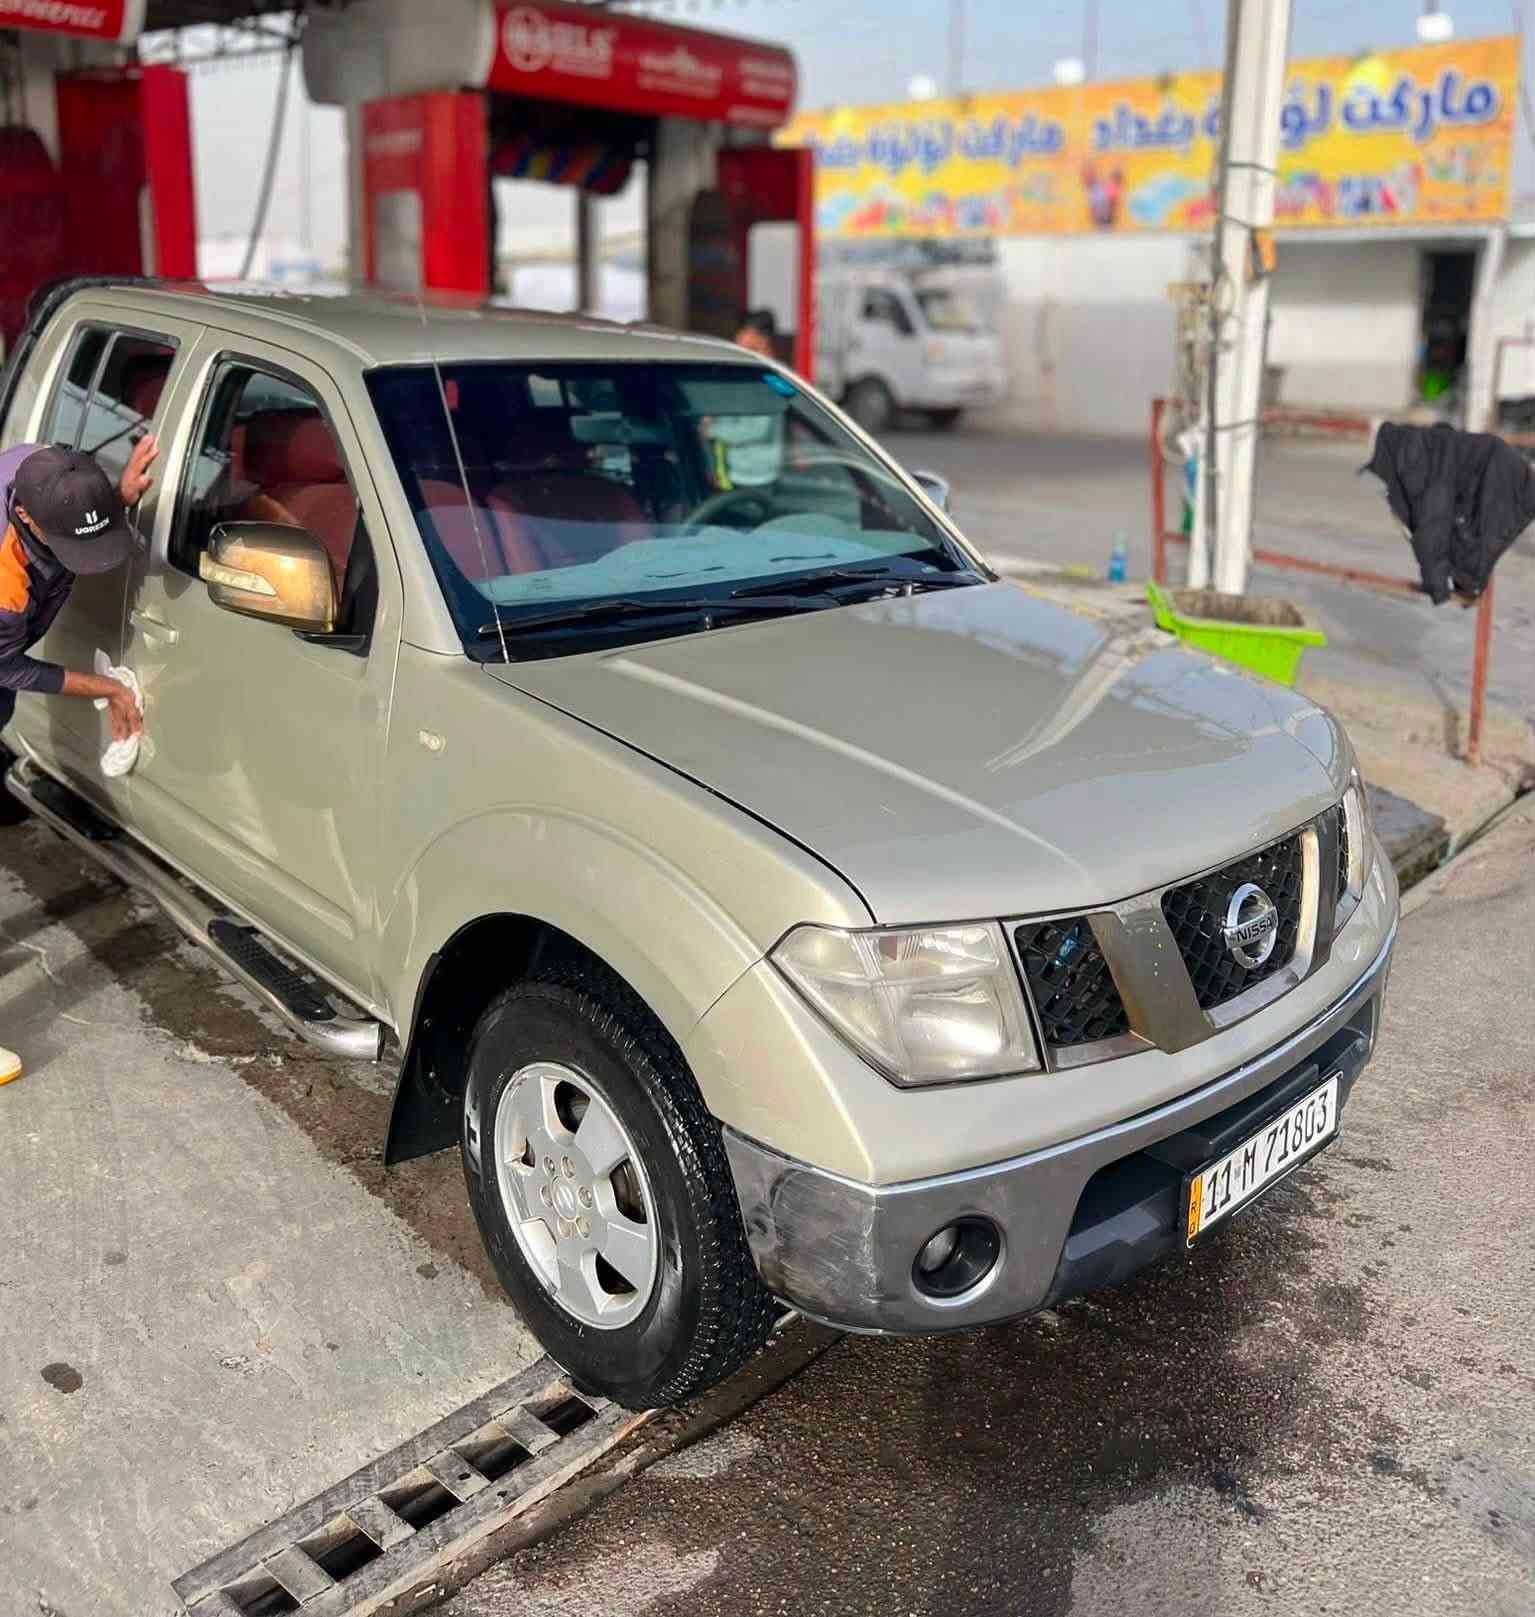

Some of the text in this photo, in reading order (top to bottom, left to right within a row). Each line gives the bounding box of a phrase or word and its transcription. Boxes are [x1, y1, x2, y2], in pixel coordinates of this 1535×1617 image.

[1094, 102, 1195, 154] بغداد
[1344, 71, 1495, 140] ماركت
[1236, 912, 1278, 941] NISSAN
[1205, 1089, 1328, 1218] 11 M 71803
